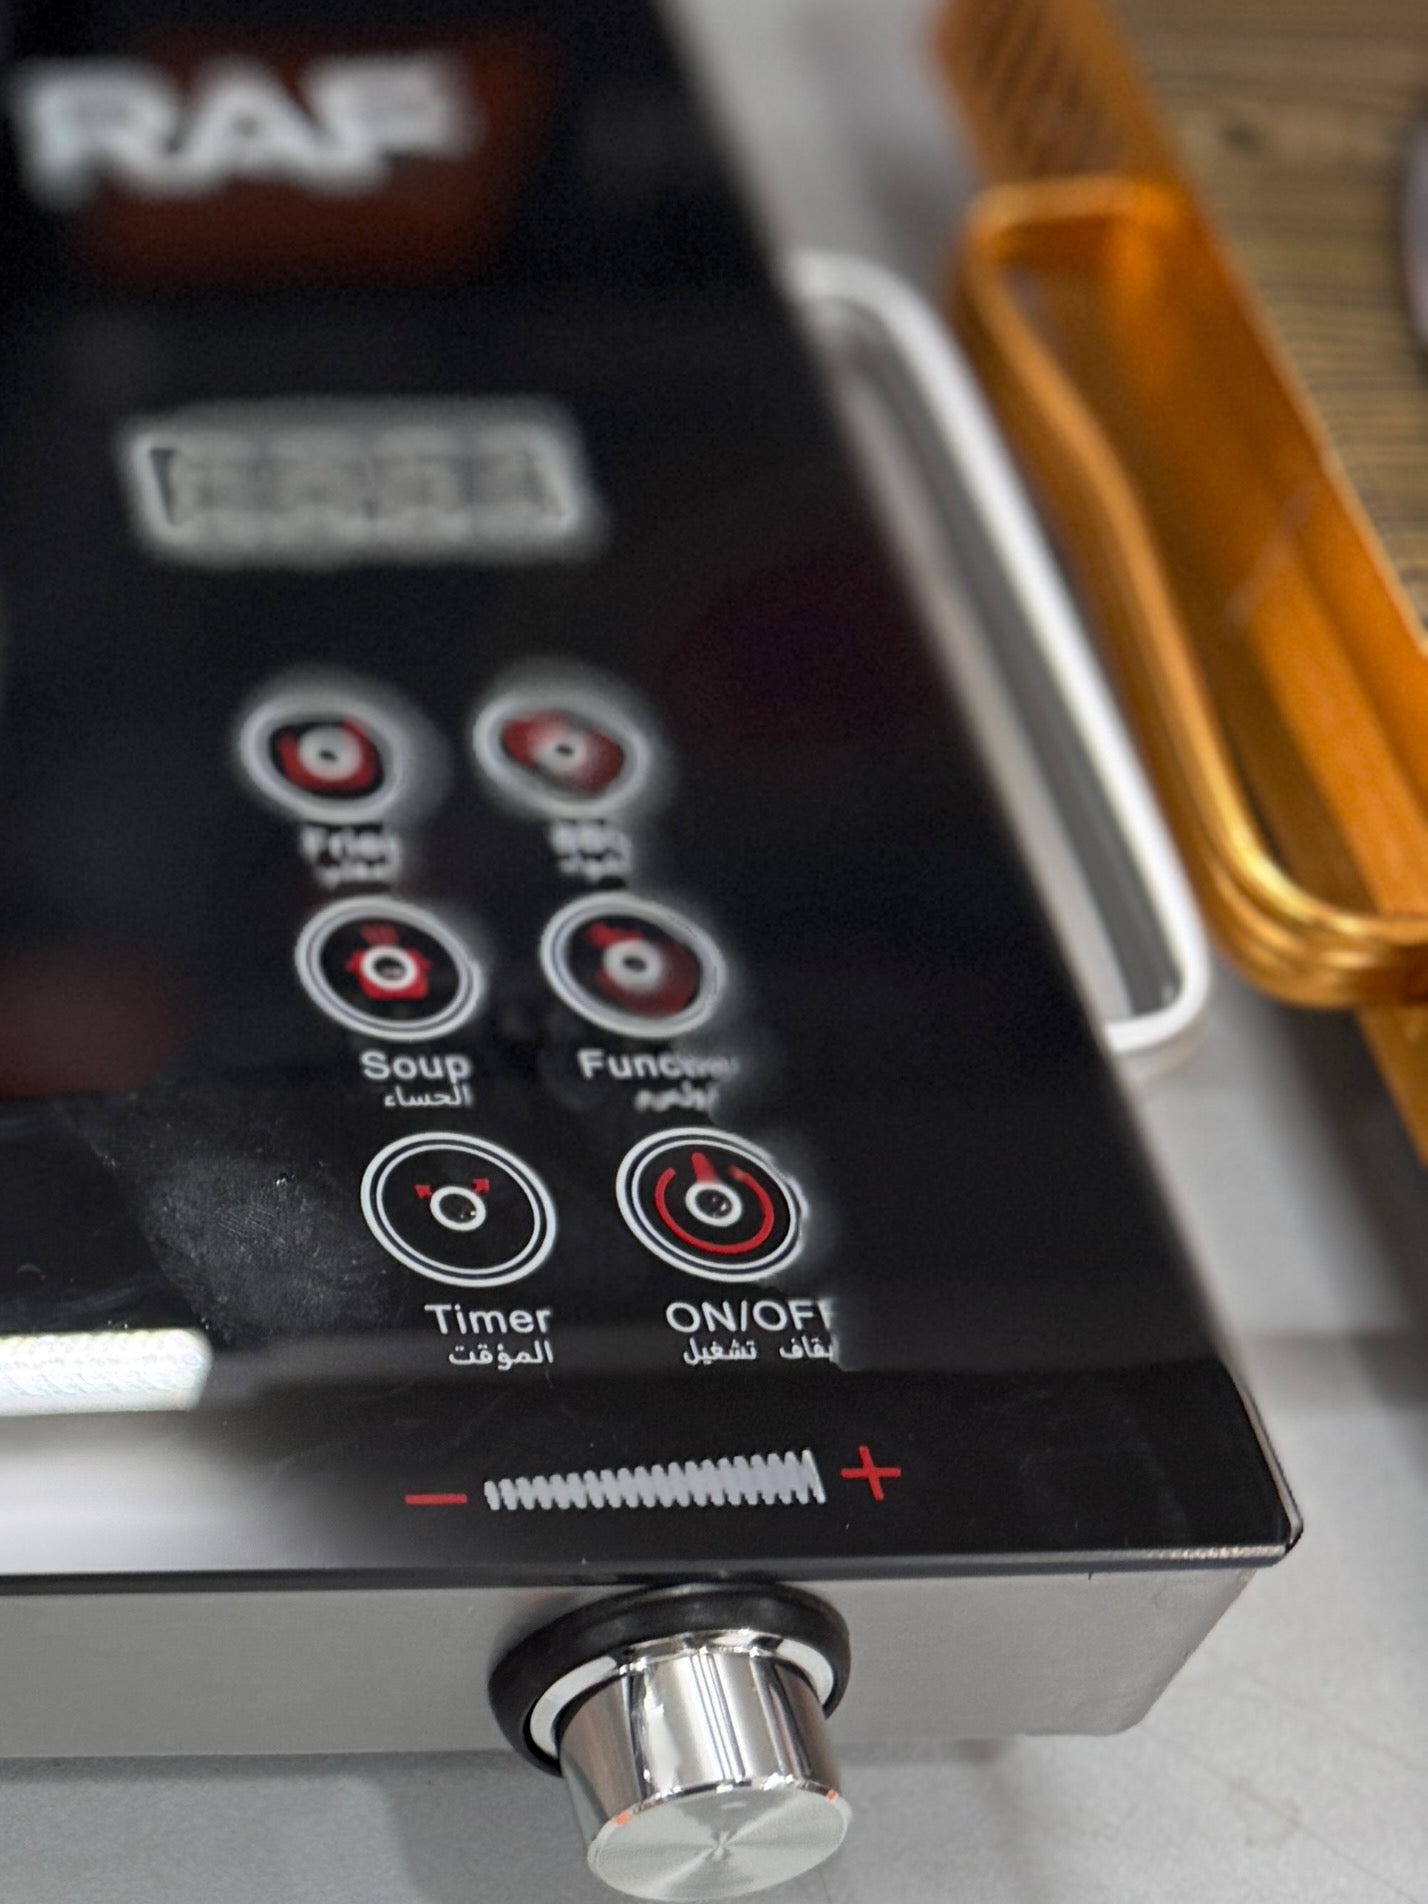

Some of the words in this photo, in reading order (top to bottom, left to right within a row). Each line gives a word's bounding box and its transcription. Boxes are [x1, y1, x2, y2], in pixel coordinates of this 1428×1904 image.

[12, 54, 479, 204] RAF
[359, 1048, 472, 1084] Soup
[424, 1303, 551, 1336] Timer
[448, 1340, 554, 1371] المؤقت
[682, 1338, 758, 1366] تشغيل
